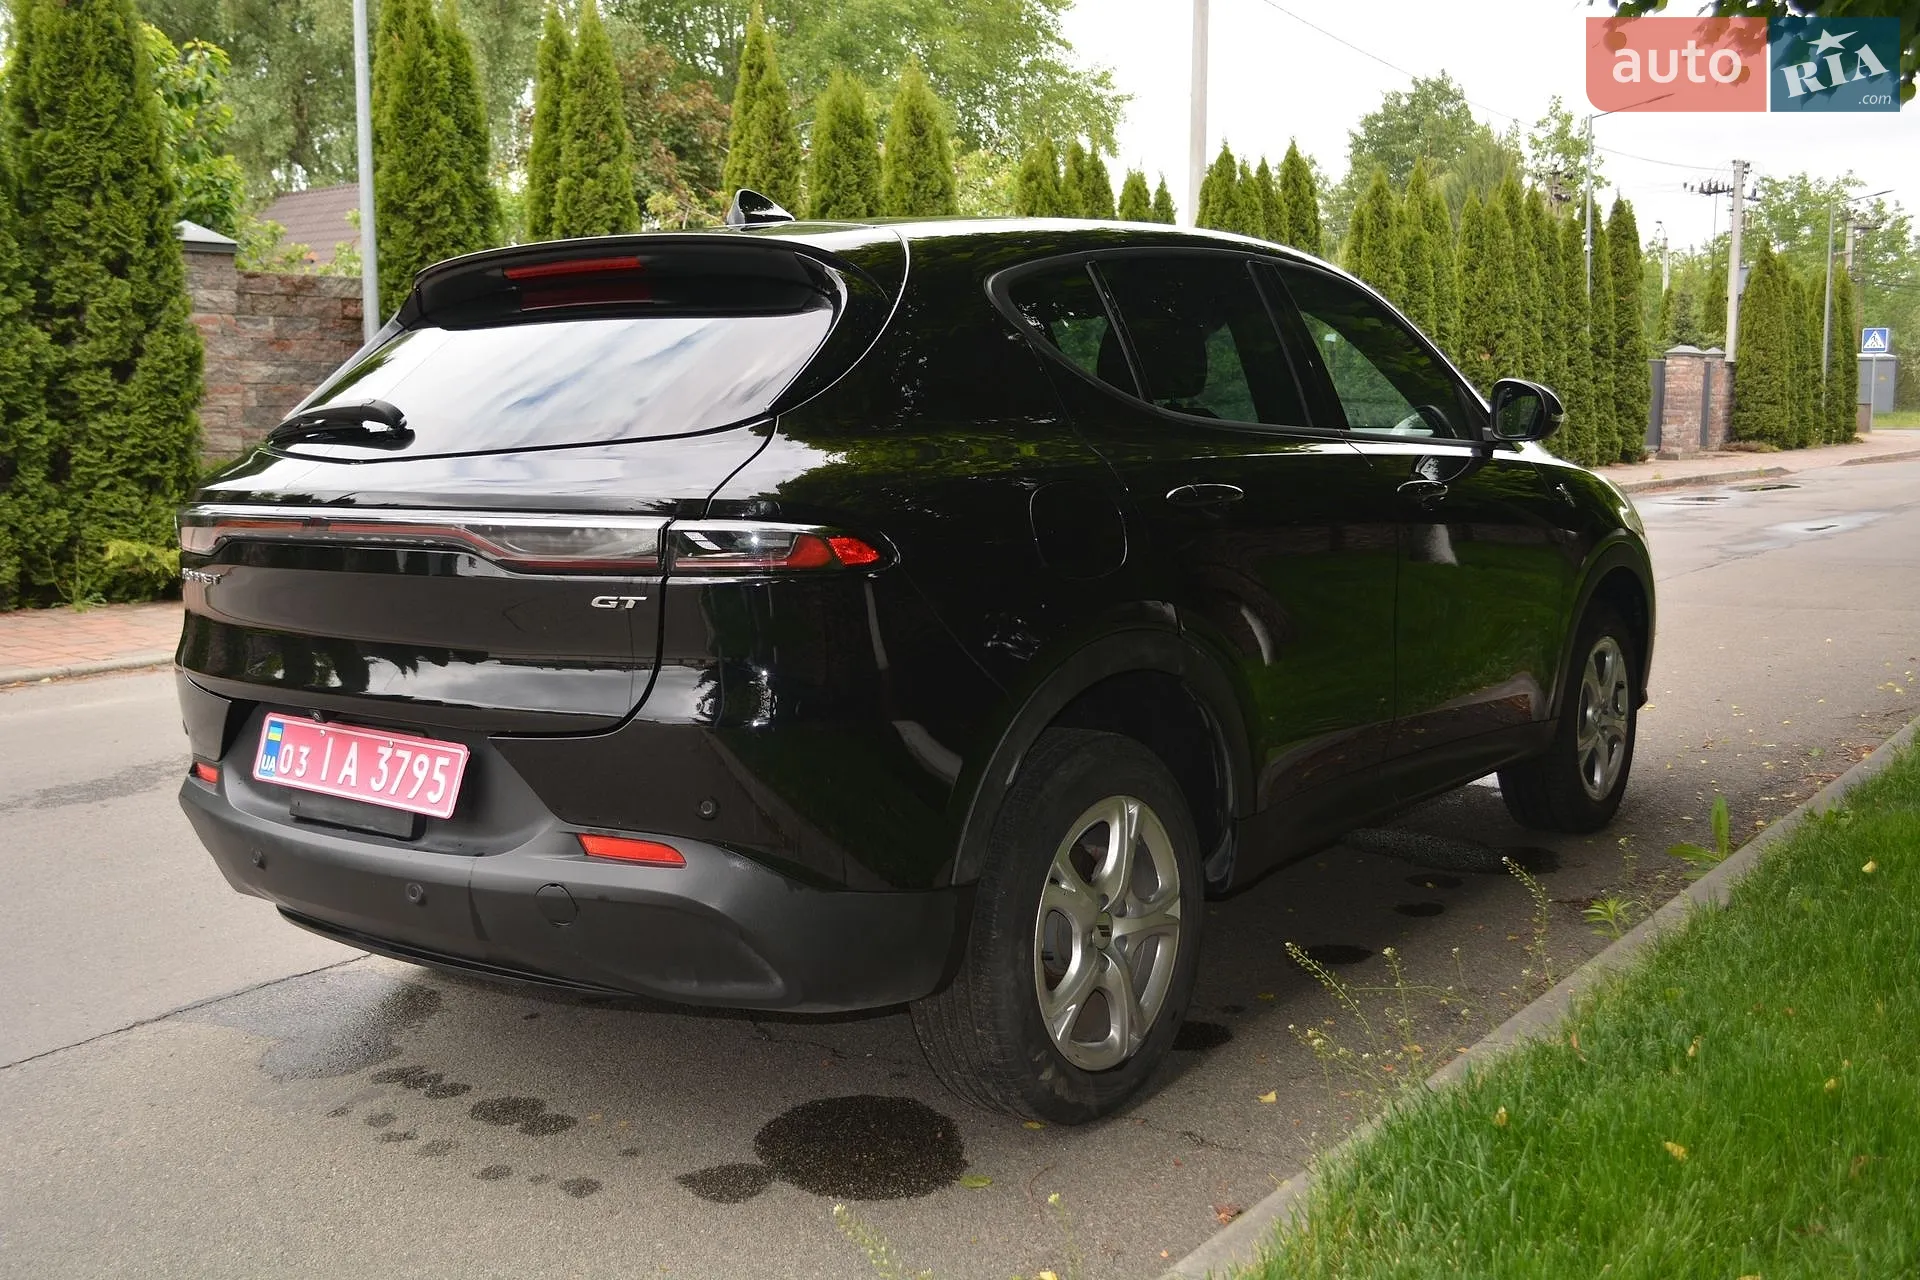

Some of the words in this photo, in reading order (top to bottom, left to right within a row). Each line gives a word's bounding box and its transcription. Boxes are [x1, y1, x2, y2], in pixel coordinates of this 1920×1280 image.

[591, 595, 648, 609] GT
[261, 753, 276, 772] UA
[279, 743, 311, 777] 03
[320, 737, 359, 787] IA
[370, 745, 451, 804] 3795
